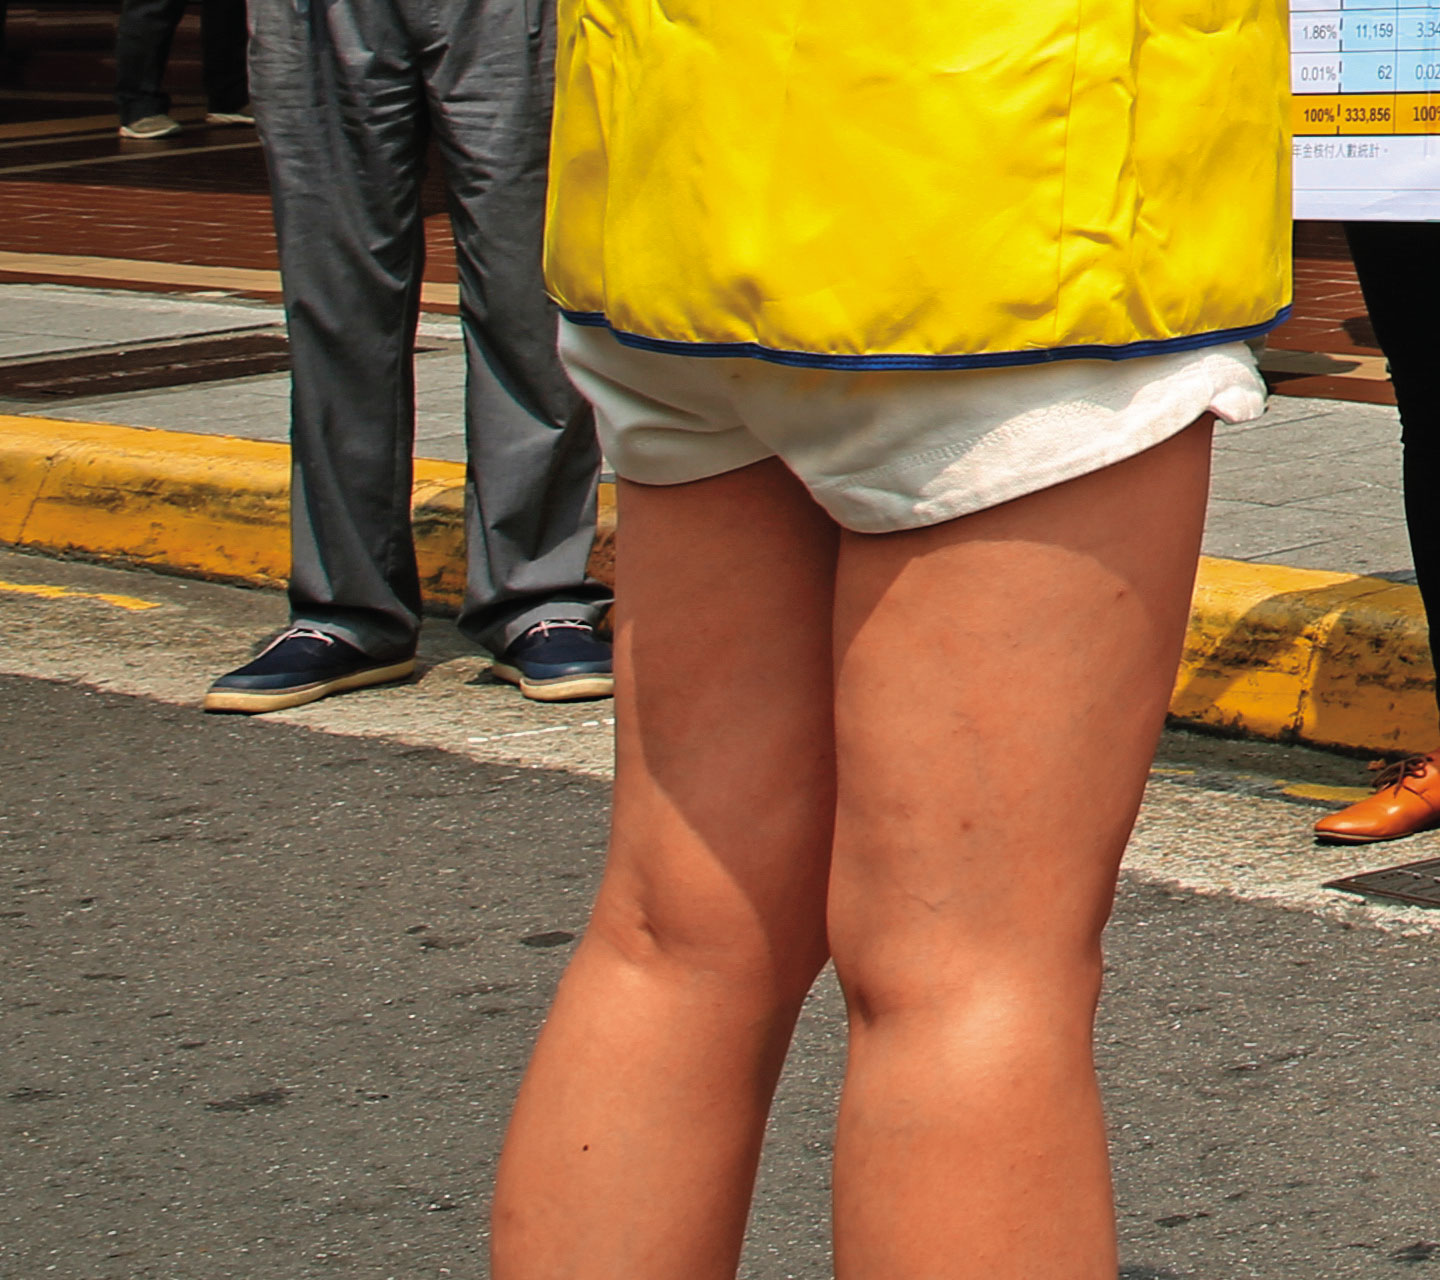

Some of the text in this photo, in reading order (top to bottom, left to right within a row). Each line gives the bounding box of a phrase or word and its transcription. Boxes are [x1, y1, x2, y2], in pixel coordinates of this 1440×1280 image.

[1303, 23, 1337, 40] 1.86%
[1356, 23, 1394, 40] 11,159
[1301, 65, 1337, 81] 0.01%
[1377, 65, 1393, 81] 62
[1304, 107, 1335, 123] 100%
[1345, 107, 1391, 124] 333,856
